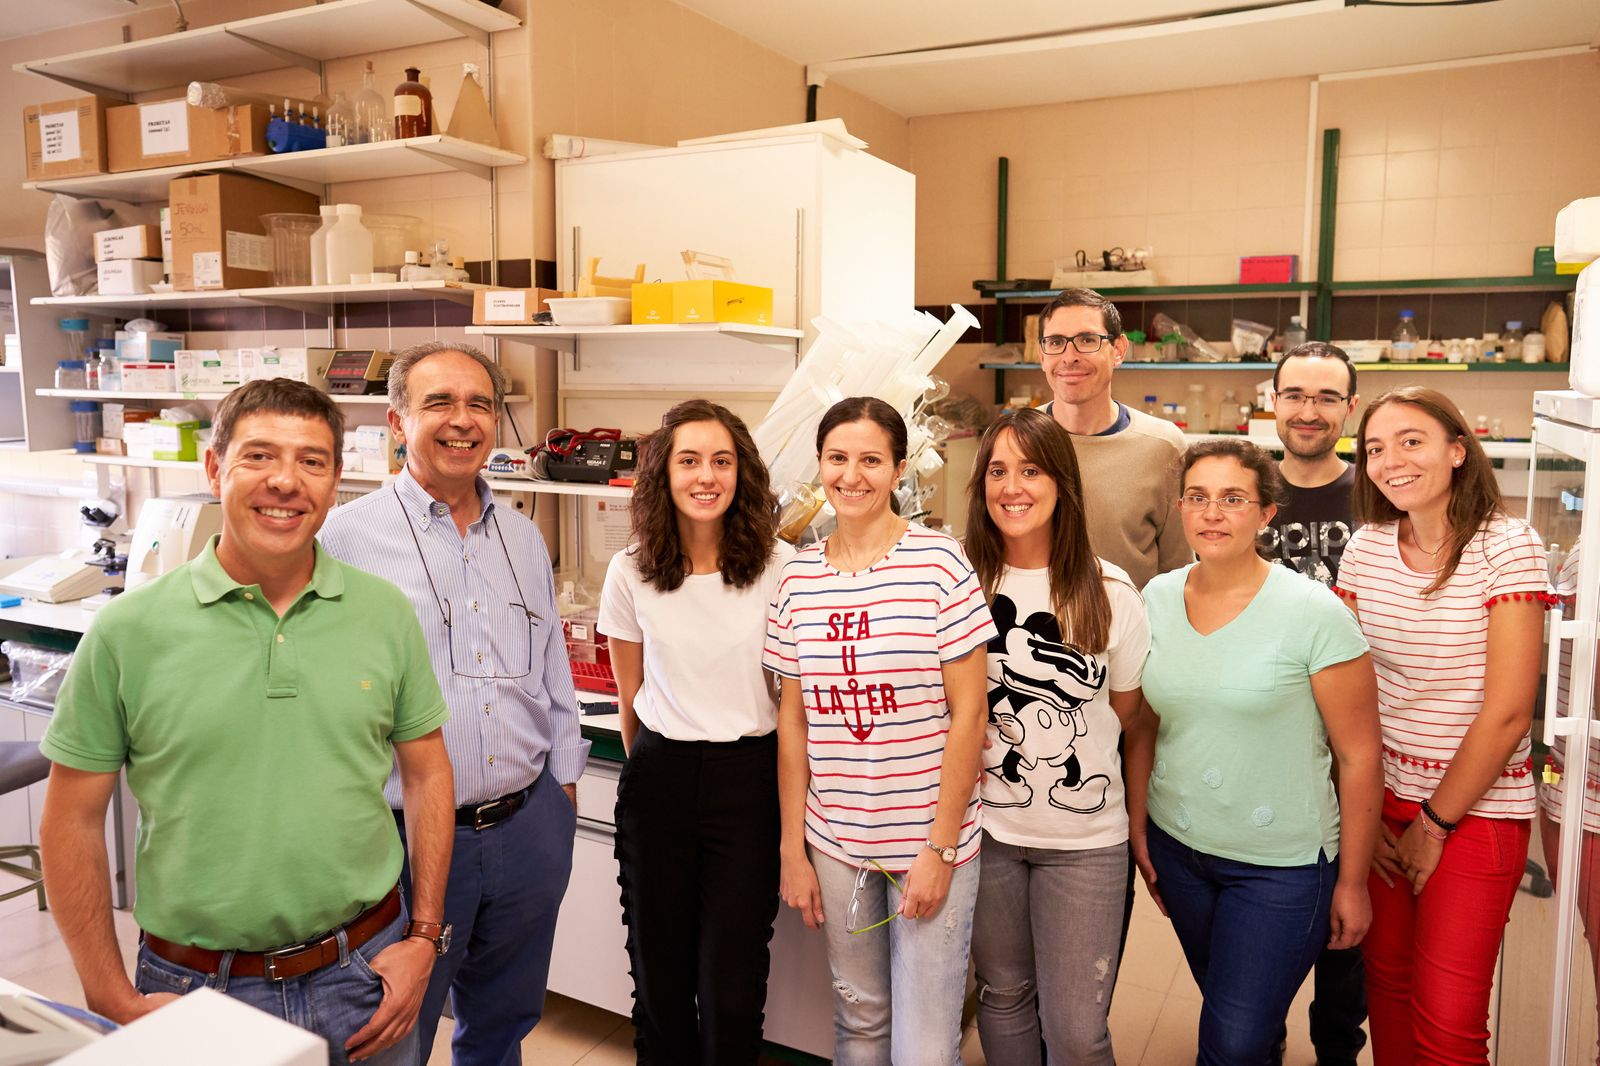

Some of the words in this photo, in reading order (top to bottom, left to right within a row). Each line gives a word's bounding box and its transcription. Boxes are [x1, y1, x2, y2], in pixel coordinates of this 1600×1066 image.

[826, 611, 870, 641] SEA
[842, 645, 856, 675] U
[813, 678, 898, 735] LATER
